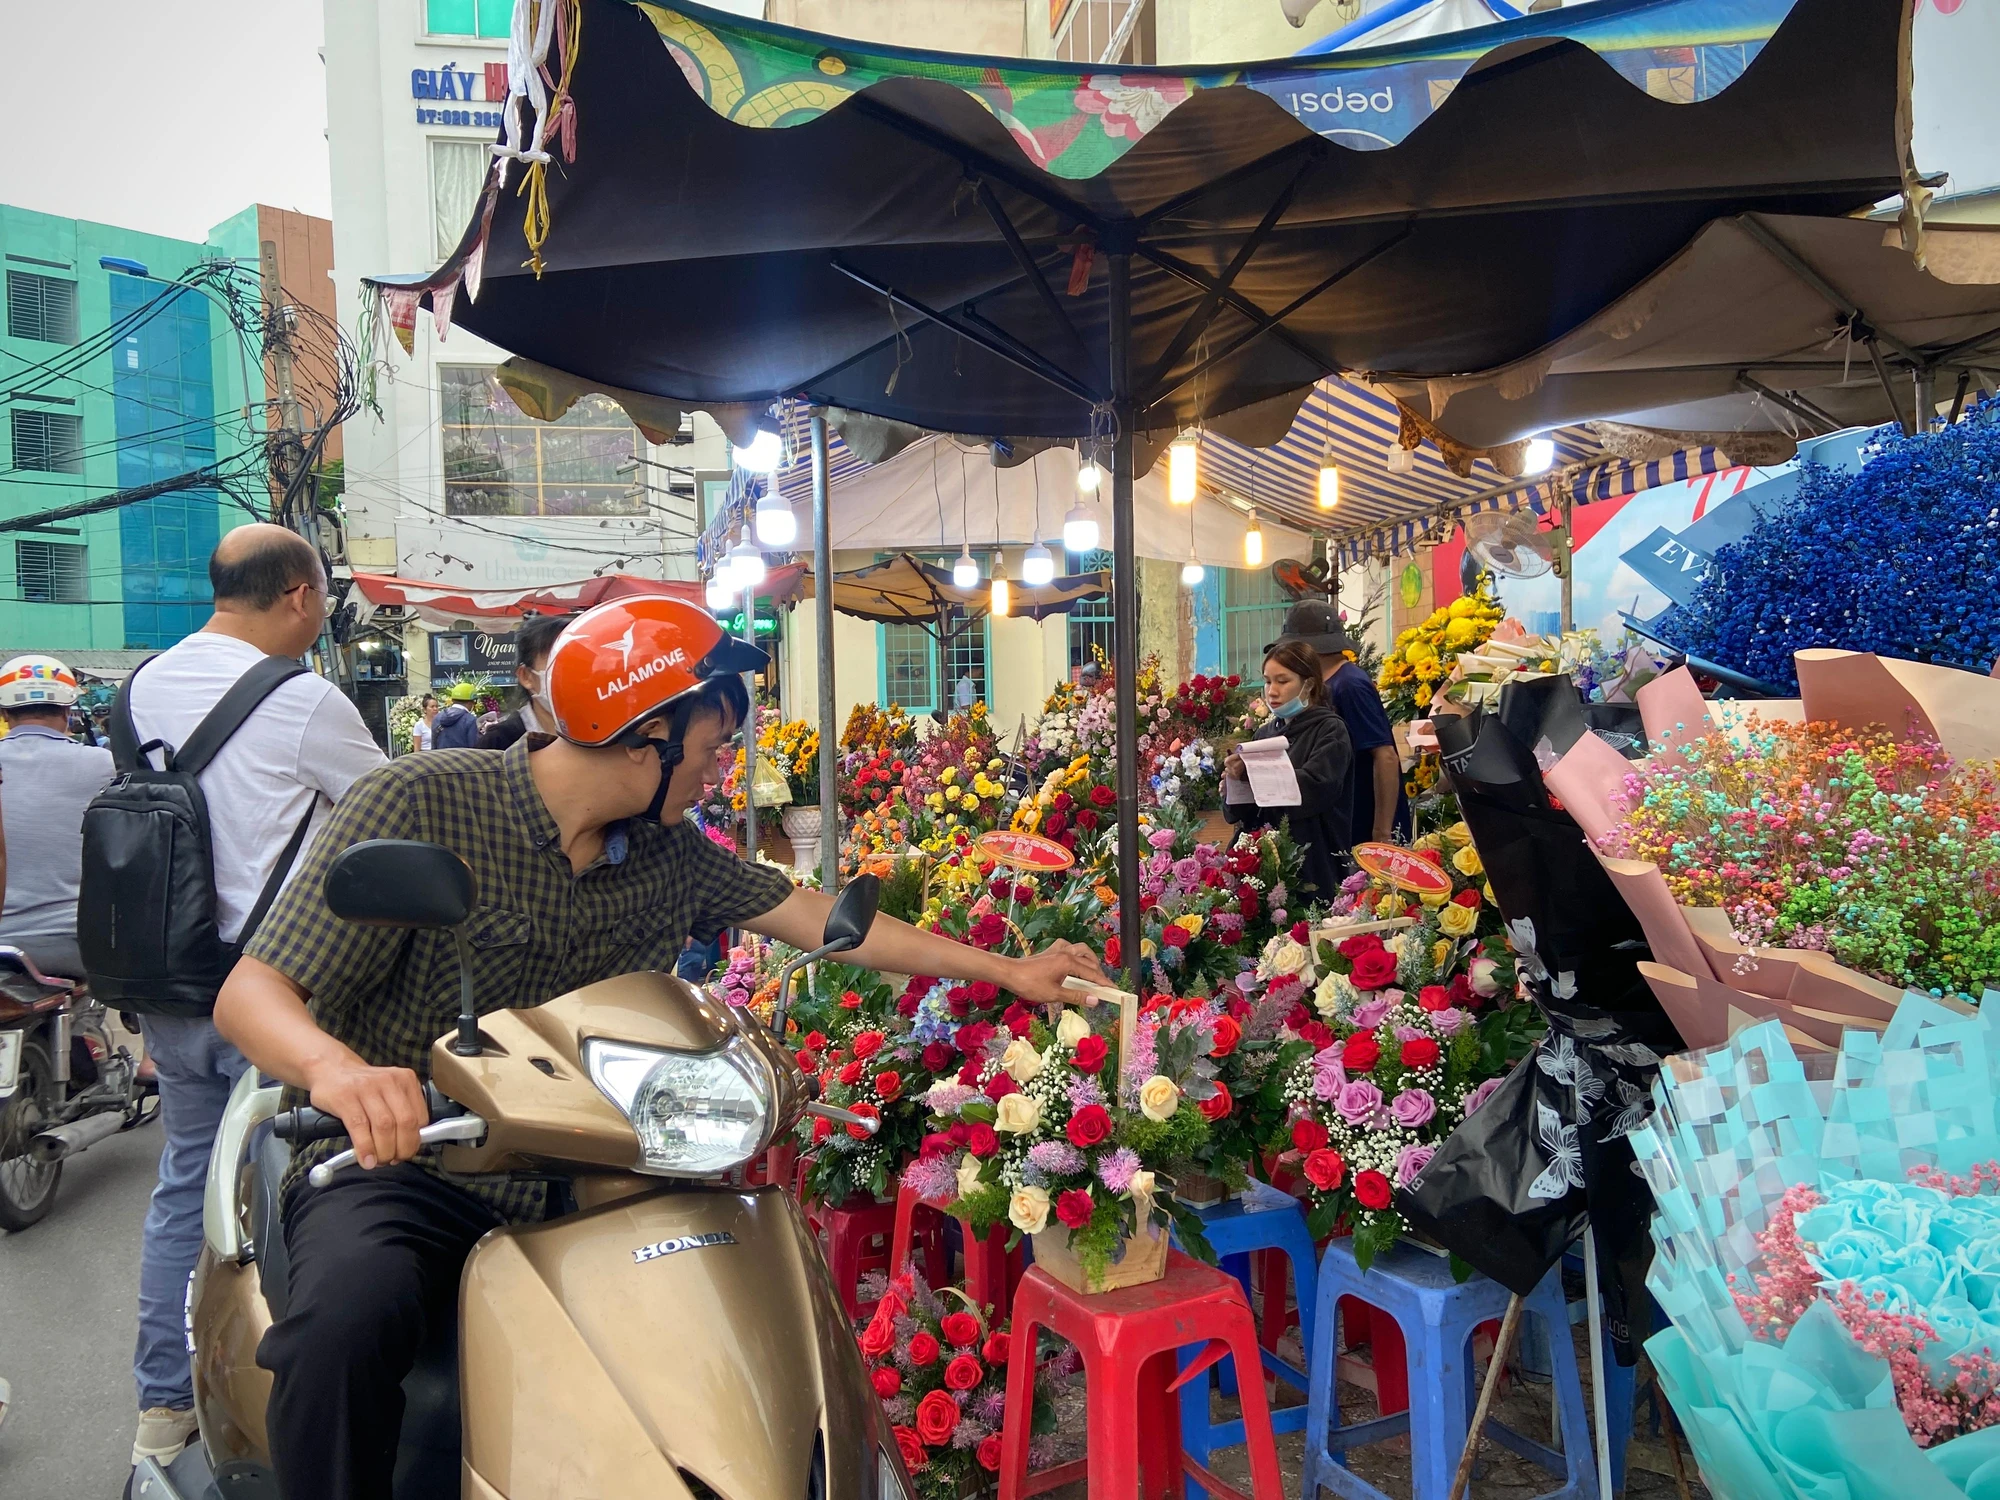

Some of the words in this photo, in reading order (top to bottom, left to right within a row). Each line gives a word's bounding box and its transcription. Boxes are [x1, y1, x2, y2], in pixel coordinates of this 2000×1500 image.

[411, 61, 476, 101] GIẤY
[1291, 86, 1394, 117] pepsi
[596, 647, 686, 701] LALAMOVE
[632, 1231, 740, 1264] HONDA
